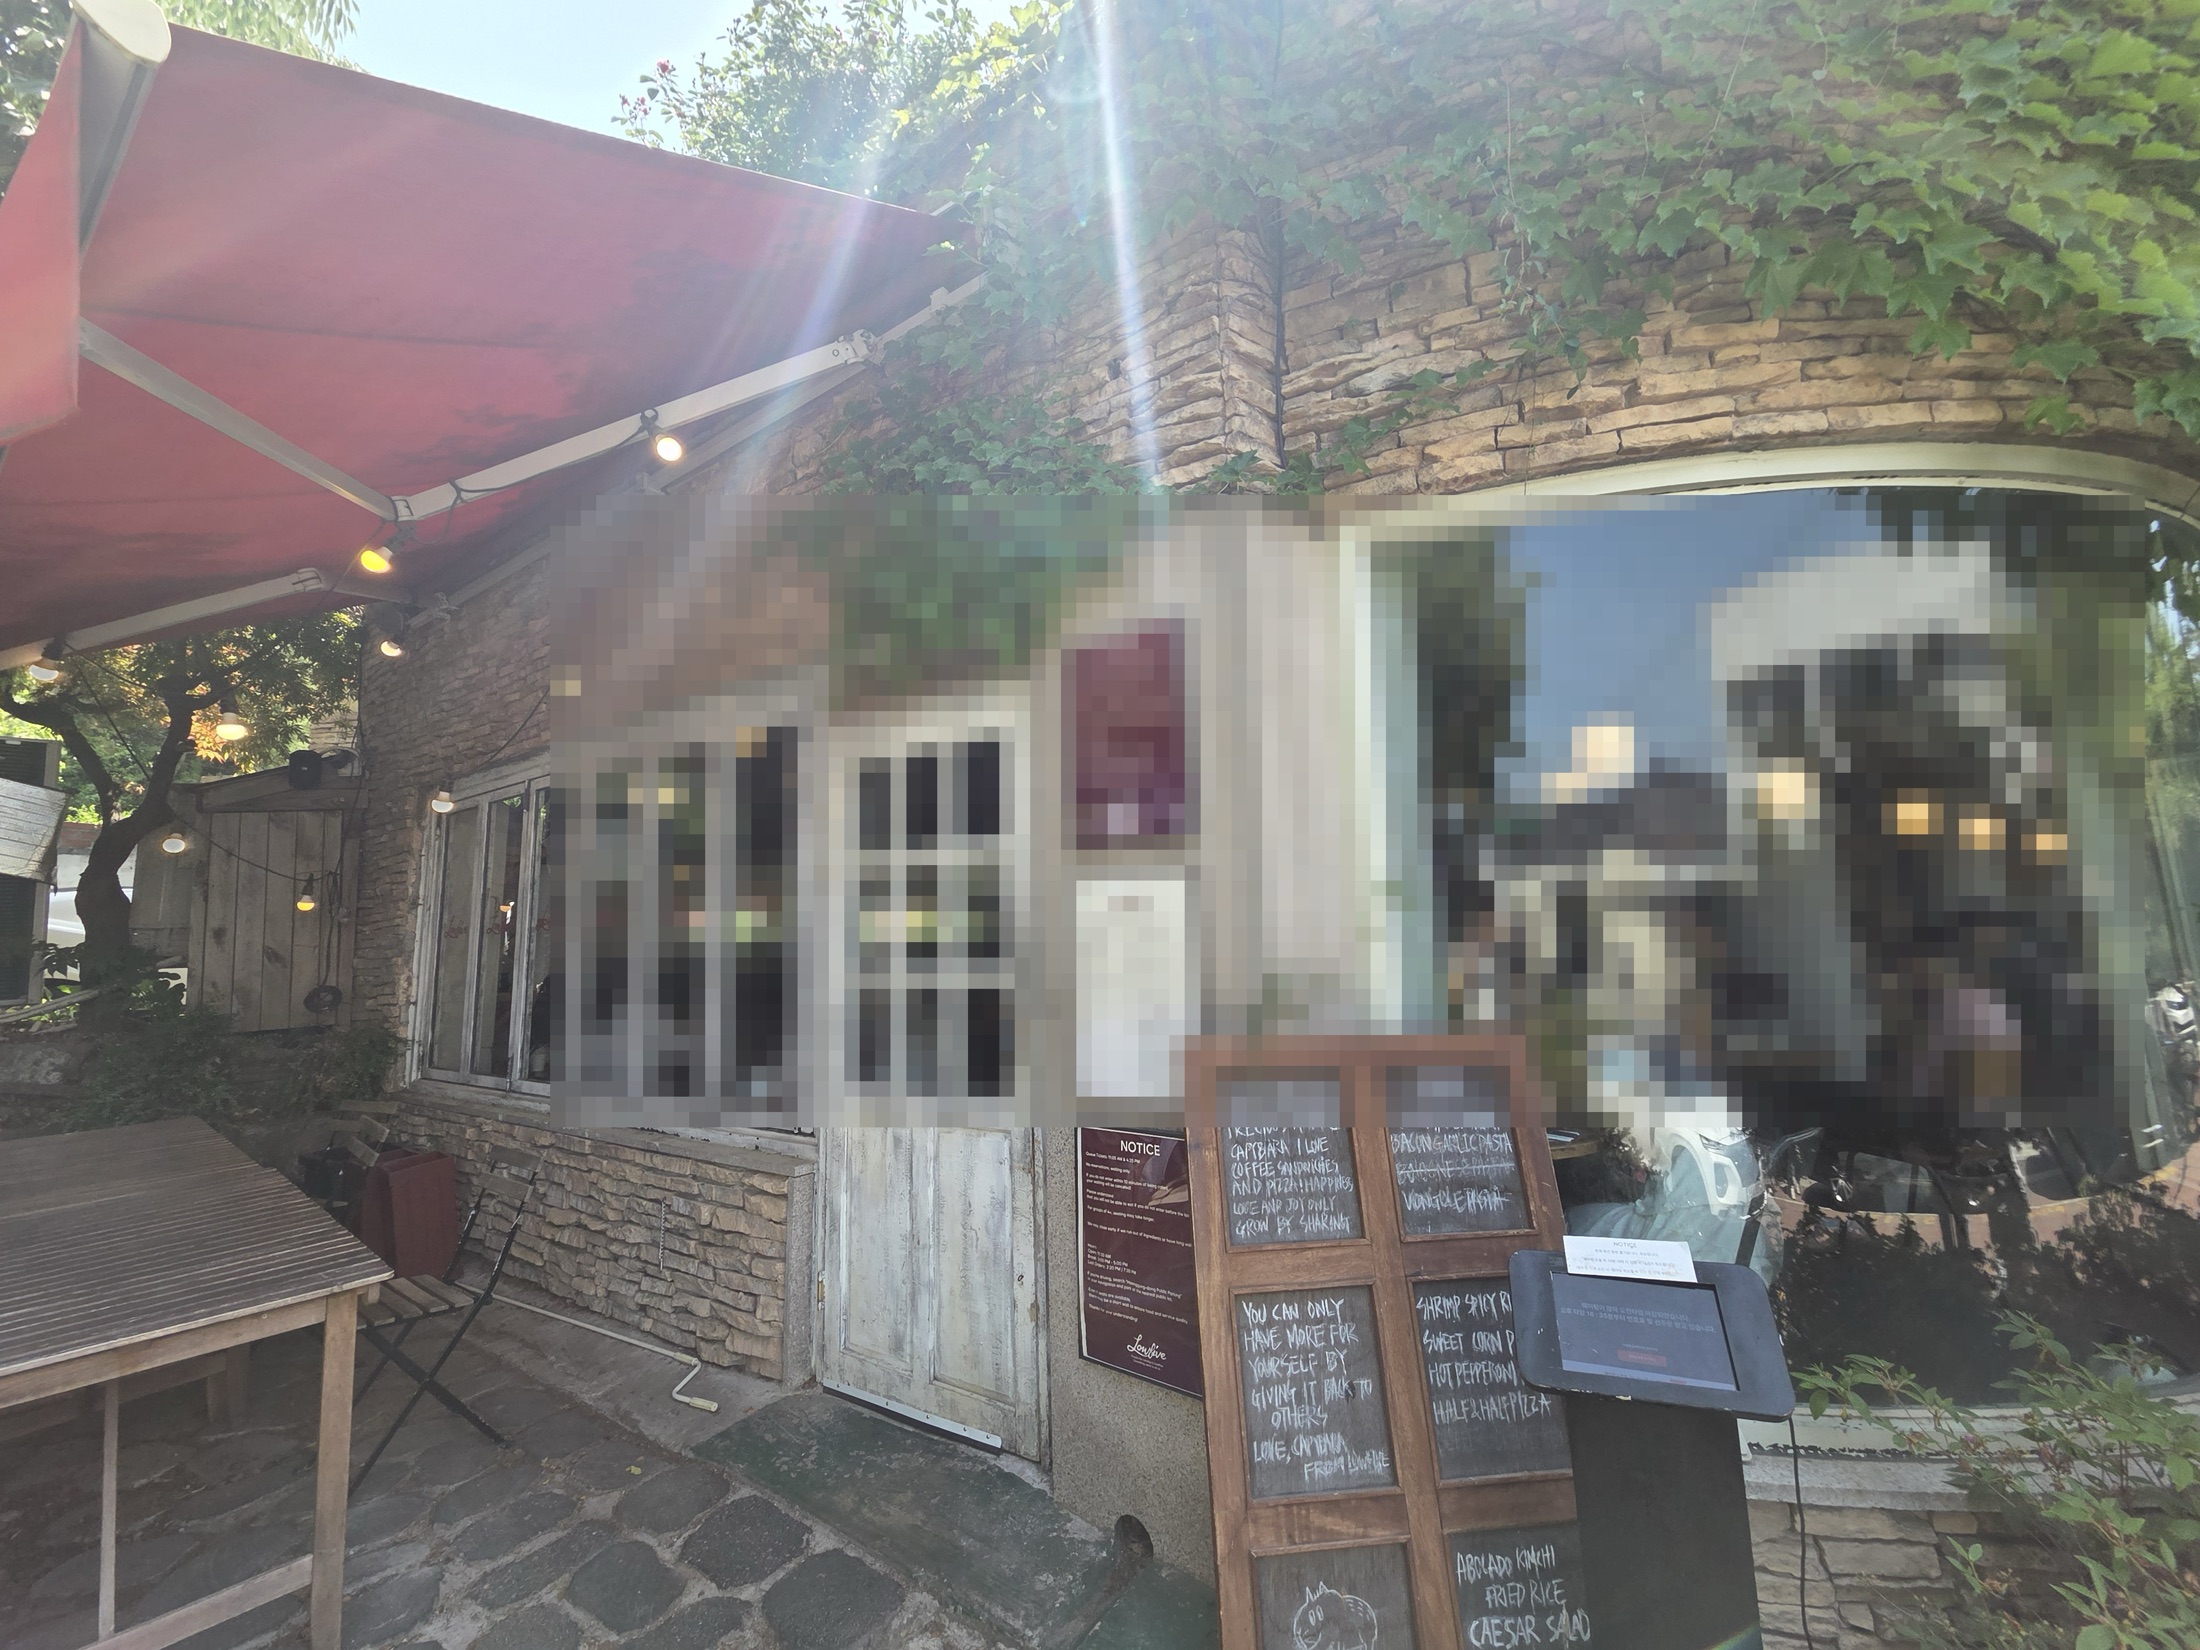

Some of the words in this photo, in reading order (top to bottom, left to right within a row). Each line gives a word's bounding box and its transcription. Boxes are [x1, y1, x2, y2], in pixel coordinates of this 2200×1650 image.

[1120, 1140, 1161, 1156] NOTICE
[1305, 1136, 1329, 1154] LOVE
[1231, 1161, 1276, 1180] COFFEE
[1232, 1178, 1262, 1196] AND
[1286, 1196, 1306, 1214] JOY
[1308, 1195, 1336, 1212] ONLY
[1236, 1216, 1269, 1239] GROW
[1276, 1216, 1295, 1236] BY
[1299, 1212, 1350, 1234] SHARING
[1242, 1300, 1267, 1329] YOU
[1272, 1302, 1300, 1321] CAN
[1308, 1298, 1345, 1324] ONLY
[1416, 1294, 1460, 1320] SHRIMP
[1465, 1292, 1498, 1321] SPICY
[1244, 1326, 1282, 1353] HAVE
[1286, 1323, 1326, 1350] MORE
[1330, 1322, 1359, 1346] FOR
[1423, 1329, 1464, 1354] SWEET
[1472, 1330, 1502, 1355] CORN
[1248, 1353, 1318, 1383] YOURSELF
[1326, 1348, 1348, 1376] BY
[1428, 1362, 1454, 1390] HOT
[1252, 1380, 1297, 1412] GIVING
[1303, 1380, 1317, 1408] IT
[1352, 1378, 1372, 1400] TO
[1271, 1405, 1328, 1432] OTHERS
[1304, 1455, 1345, 1482] FROM
[1516, 1544, 1556, 1578] KIMCHI
[1485, 1582, 1526, 1609] FRIED
[1529, 1578, 1566, 1614] RICE
[1468, 1614, 1541, 1650] CAESAR
[1546, 1607, 1591, 1646] SALAD
